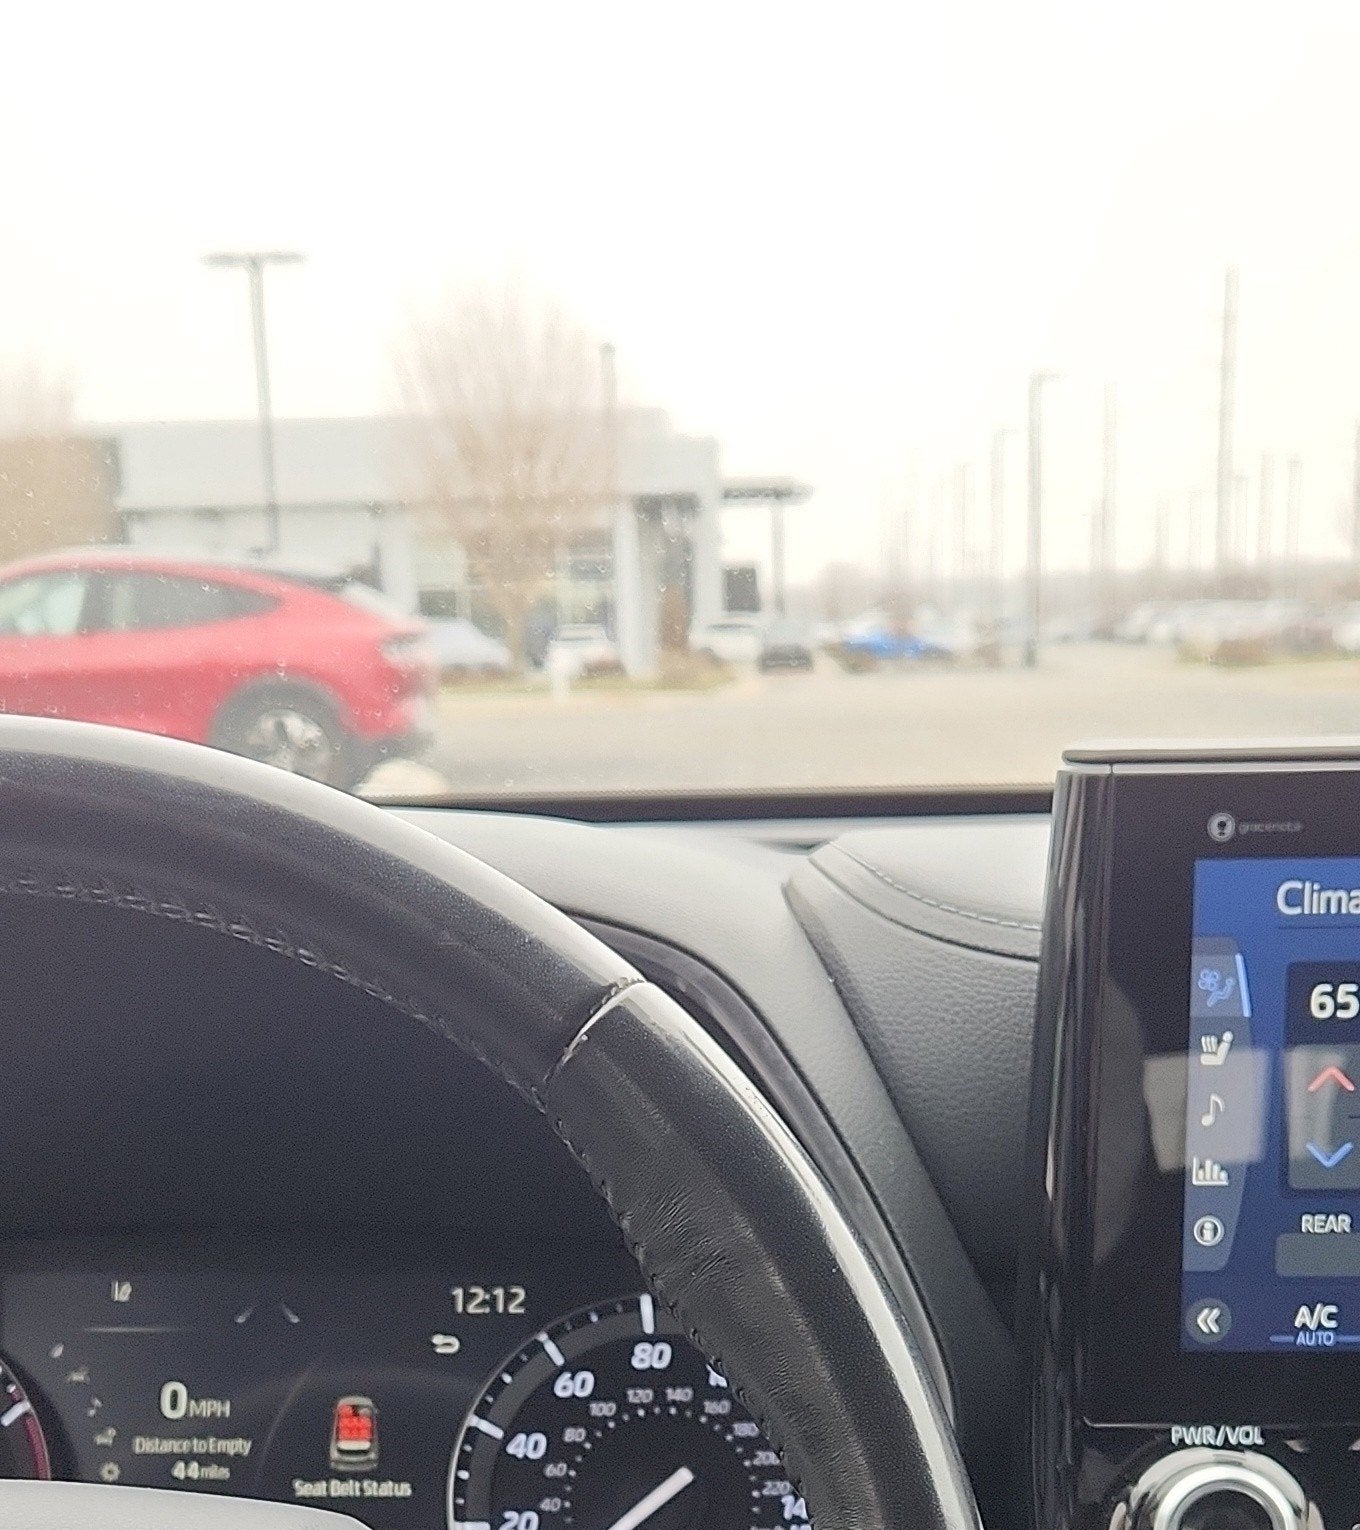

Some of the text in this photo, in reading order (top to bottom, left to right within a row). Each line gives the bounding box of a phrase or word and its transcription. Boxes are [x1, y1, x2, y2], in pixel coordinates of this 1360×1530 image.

[1310, 983, 1360, 1020] 65
[1301, 1214, 1351, 1234] REAR
[452, 1287, 526, 1314] 12:12
[1294, 1303, 1338, 1331] A/C
[1295, 1331, 1334, 1346] AUTO
[631, 1341, 673, 1370] 80
[553, 1370, 595, 1398] 60
[160, 1381, 231, 1420] 0 MPH
[589, 1402, 617, 1418] 100
[562, 1426, 587, 1443] 80
[1171, 1426, 1265, 1446] PWR/VOL
[133, 1437, 252, 1457] Distance to Empty
[506, 1432, 548, 1460] 40
[171, 1460, 231, 1480] 44 miles
[544, 1461, 568, 1478] 60
[293, 1478, 413, 1498] Seat Belt Status
[540, 1497, 562, 1513] 40
